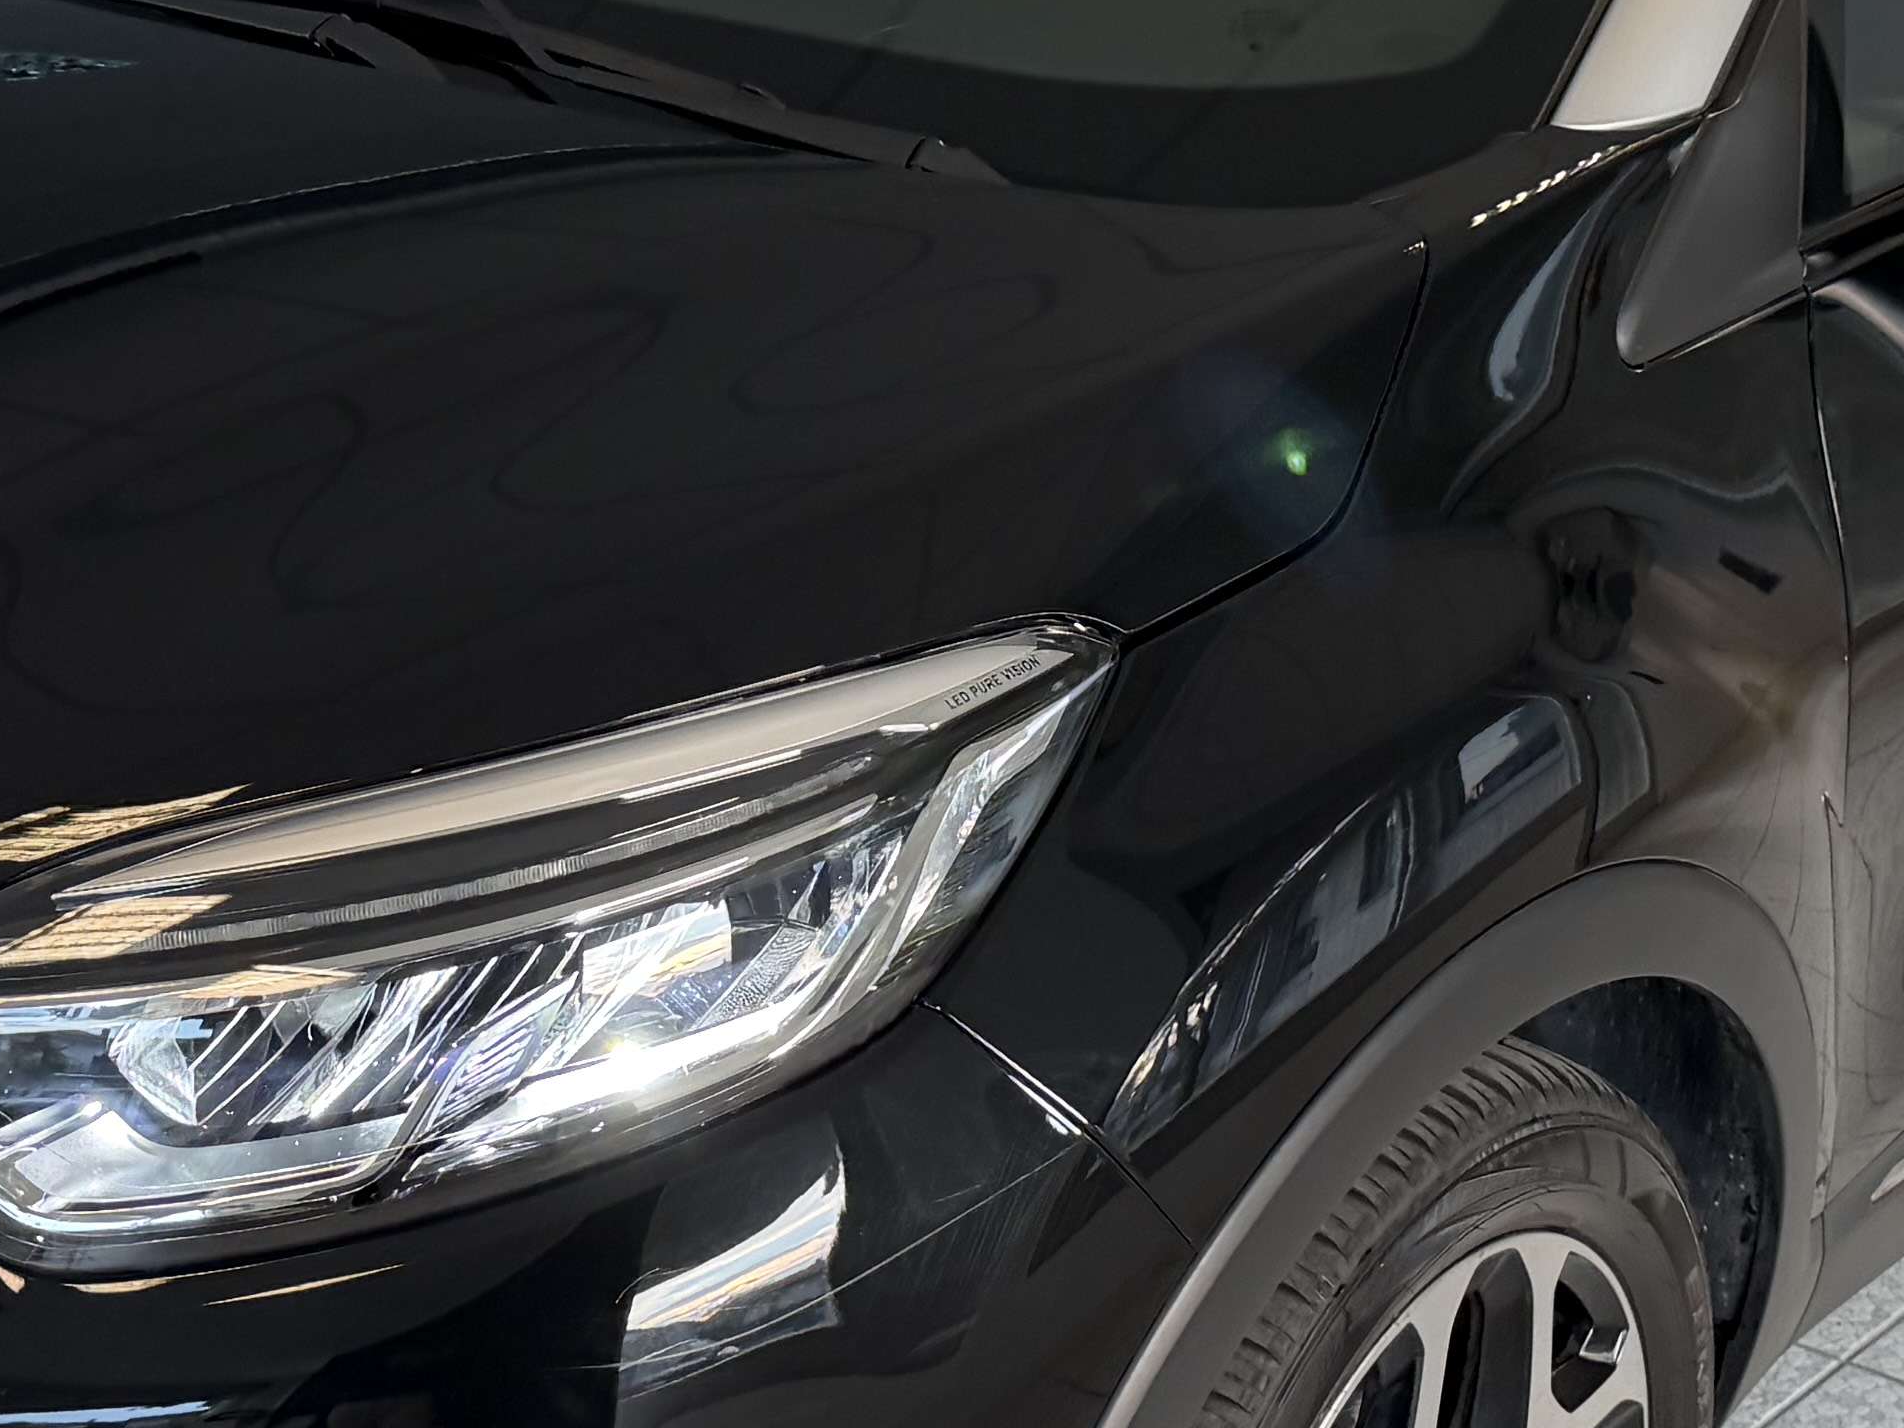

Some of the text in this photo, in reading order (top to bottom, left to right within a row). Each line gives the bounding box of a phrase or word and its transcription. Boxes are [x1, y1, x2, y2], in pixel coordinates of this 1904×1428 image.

[945, 654, 1041, 710] LED PURE VISION
